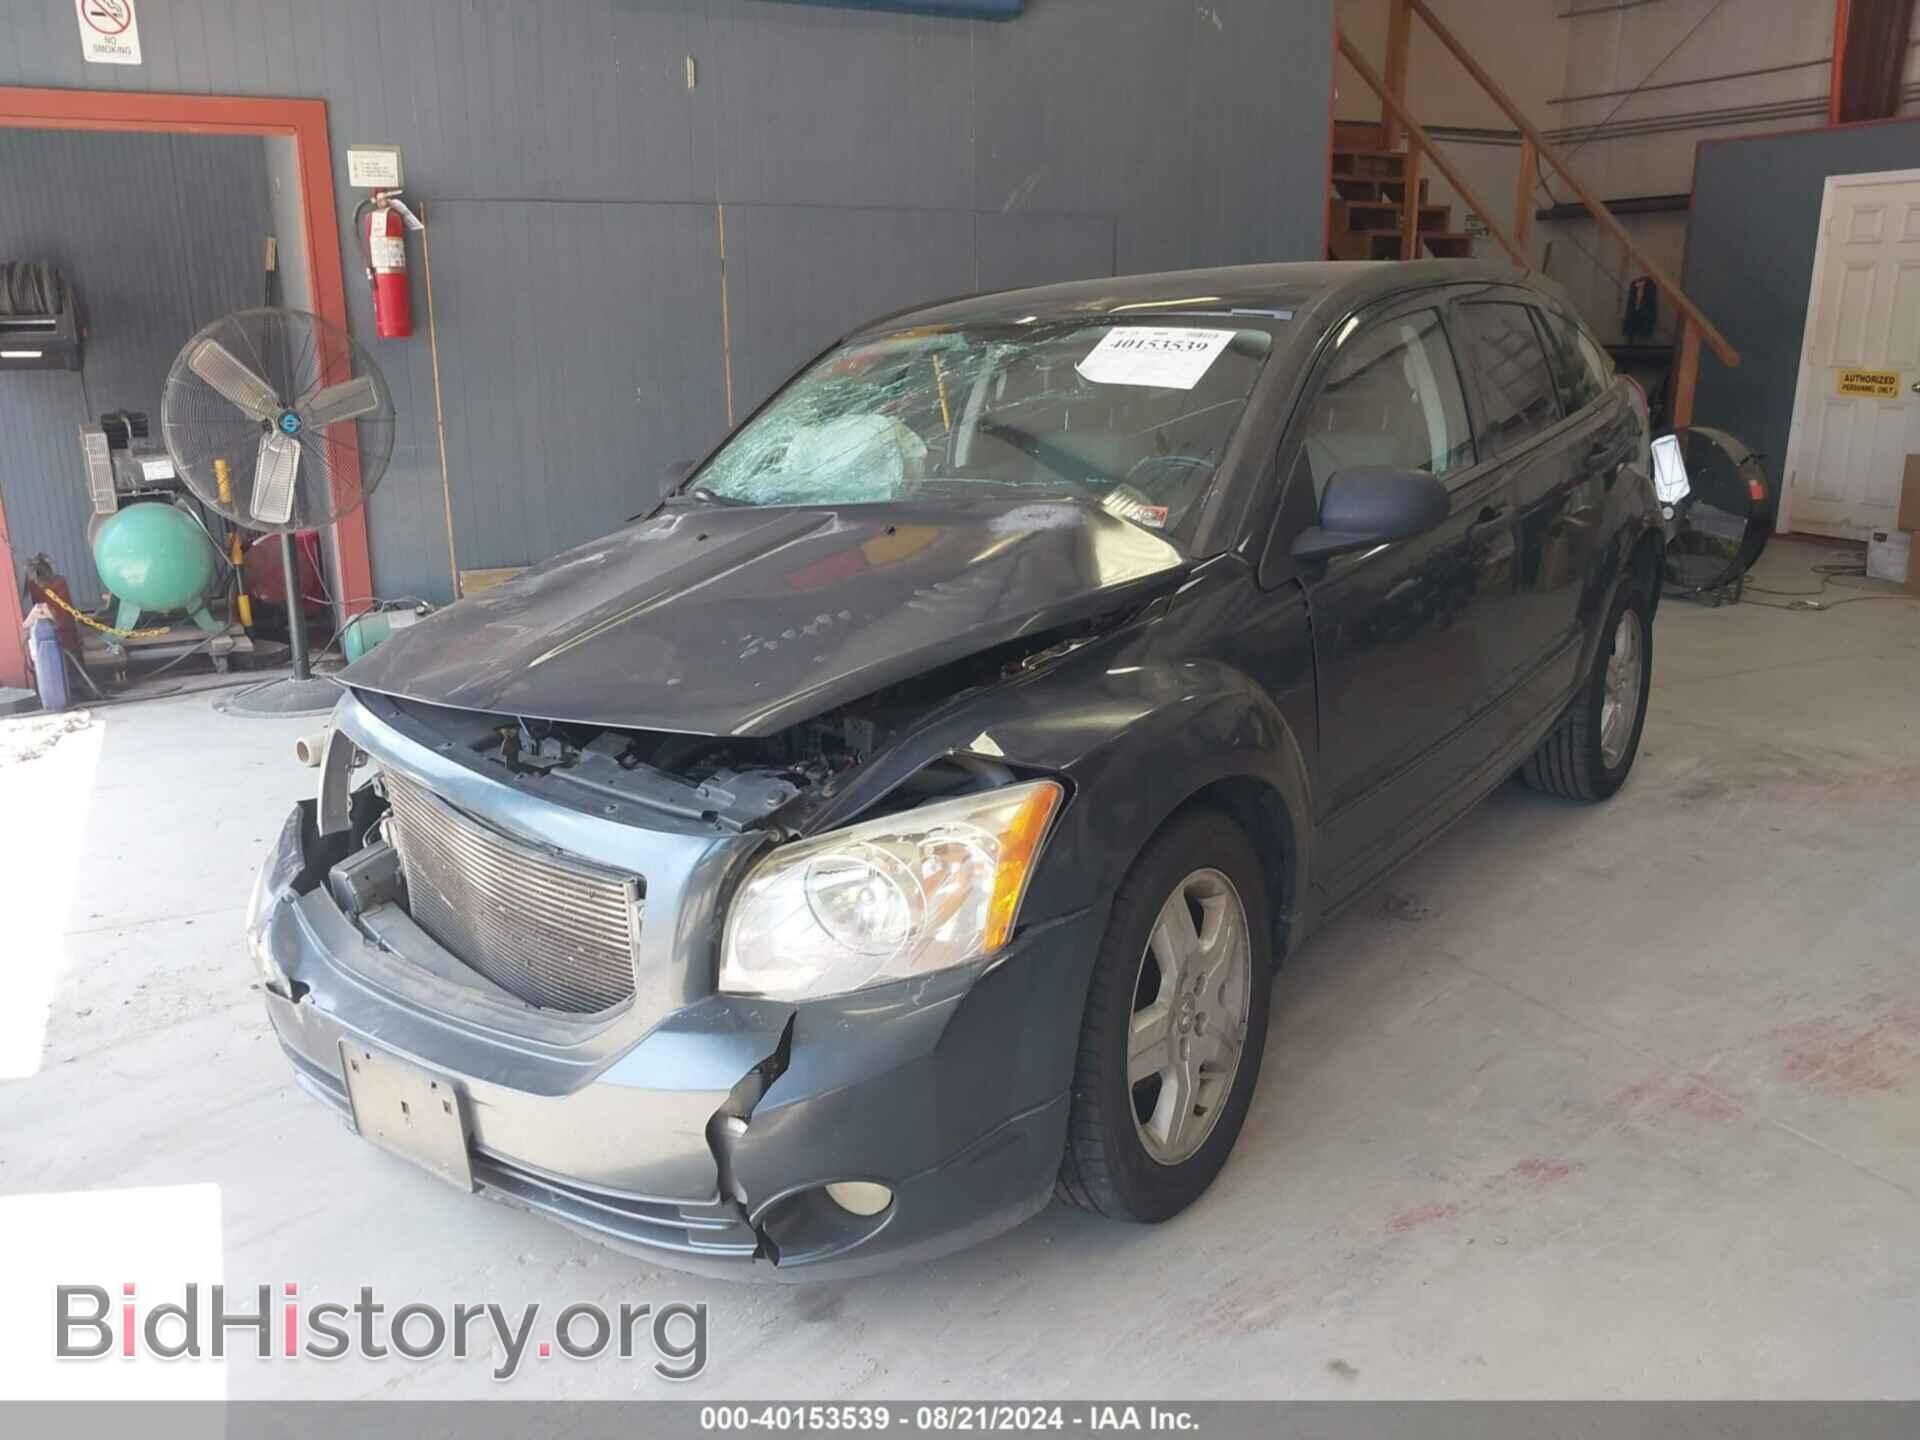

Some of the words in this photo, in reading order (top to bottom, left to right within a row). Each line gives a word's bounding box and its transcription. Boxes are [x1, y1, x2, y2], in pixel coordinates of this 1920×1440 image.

[104, 36, 117, 47] NO
[93, 44, 132, 55] SMOKING
[1110, 338, 1209, 352] 40153539
[1844, 374, 1896, 384] AUTHORIZED
